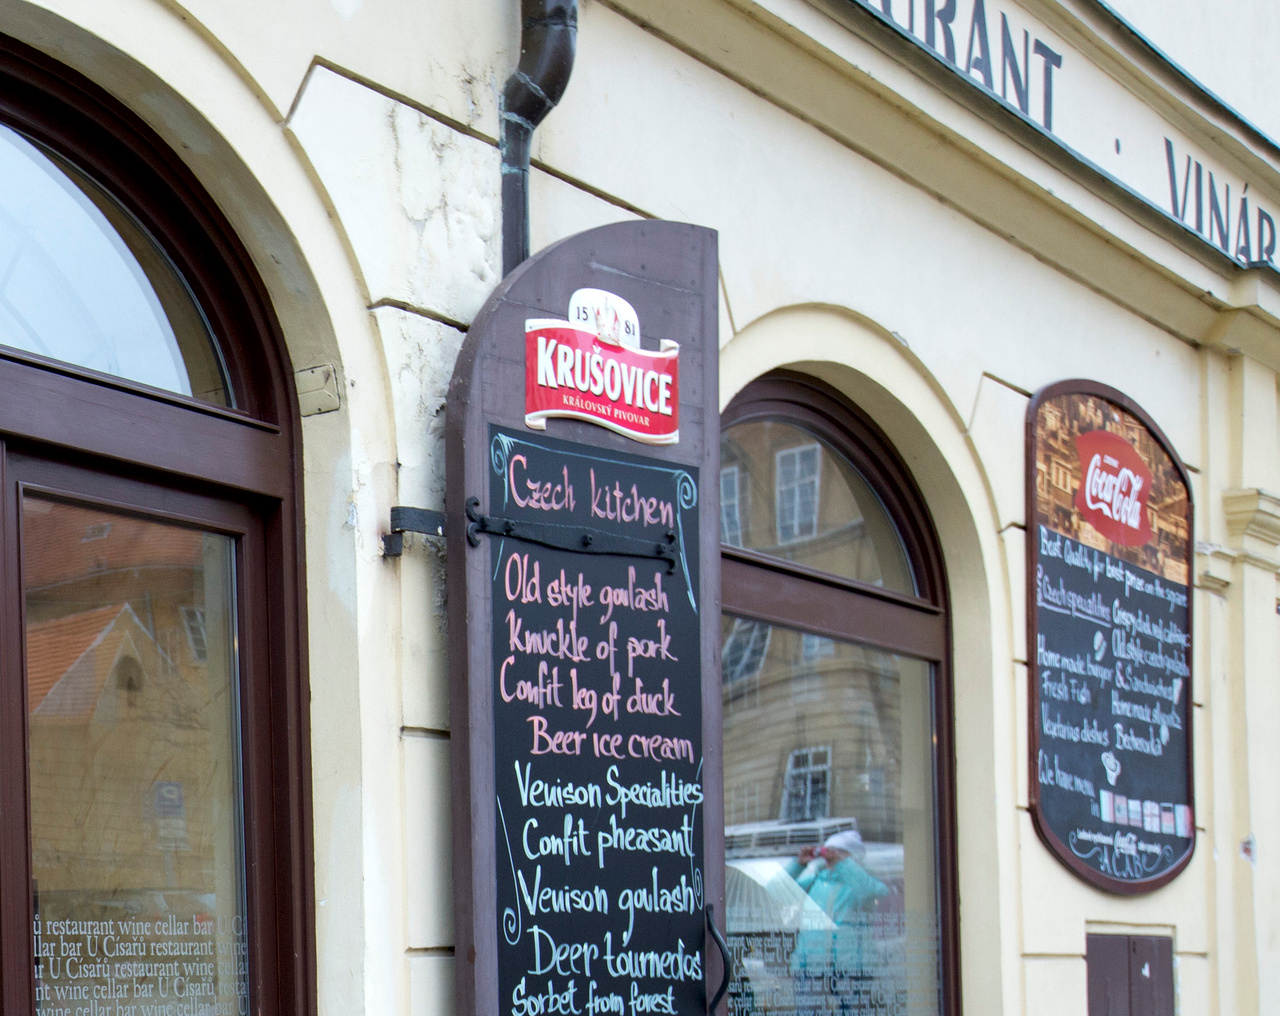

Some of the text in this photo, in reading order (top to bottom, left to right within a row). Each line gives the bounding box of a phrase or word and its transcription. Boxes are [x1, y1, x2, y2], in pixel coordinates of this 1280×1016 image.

[576, 306, 635, 335] 15 81
[537, 336, 672, 415] KRUŠOVICE
[563, 394, 649, 426] KRÁLOVSKÝ PIVOVAR
[510, 454, 674, 528] Czech kitchen
[505, 553, 669, 625] Old style goulash
[505, 609, 678, 678] Knuckle of pork
[499, 655, 681, 729] Confit leg of duck
[527, 715, 694, 764] Beer ice cream
[515, 760, 704, 819] Venison Specialities
[522, 813, 695, 868] Confit pheasant
[47, 915, 213, 935] restaurant wine cellar bar
[517, 865, 608, 915] Venison
[618, 866, 694, 947] goulash
[49, 957, 214, 979] U Císařů restaurant wine
[60, 935, 213, 957] bar U Císařů restaurant
[527, 925, 598, 977] Deer
[603, 931, 702, 981] tournedos
[54, 978, 128, 1000] wine cellar
